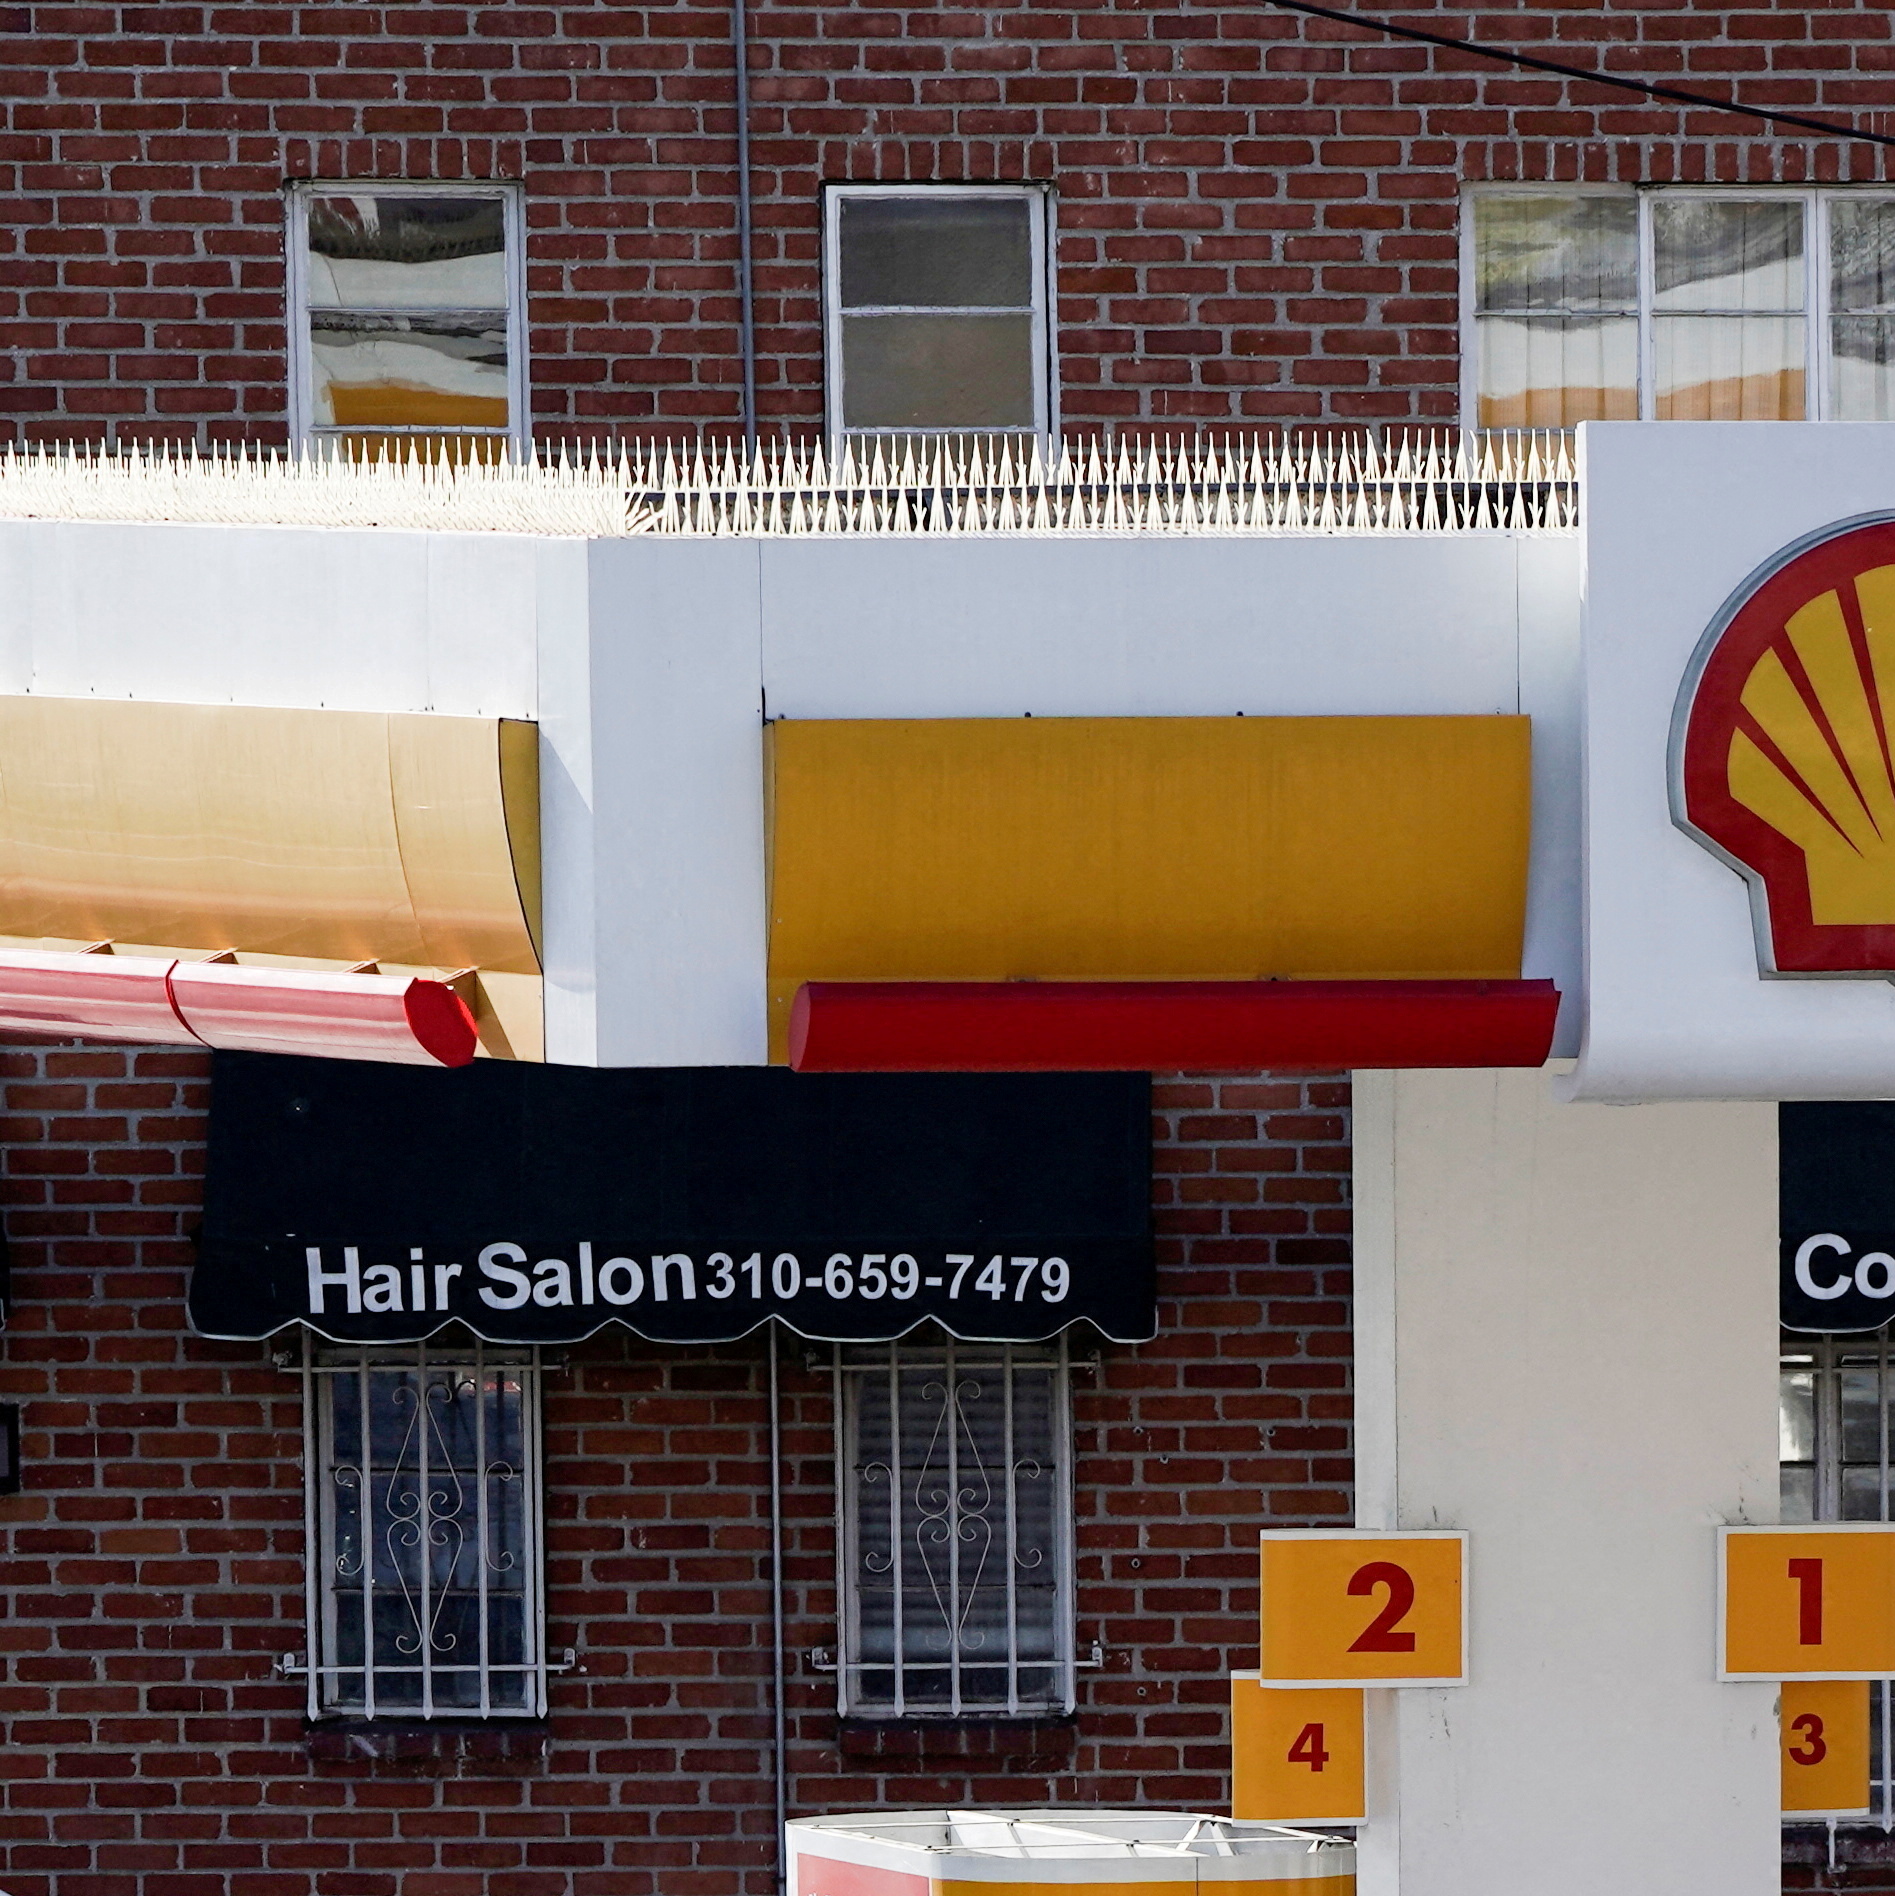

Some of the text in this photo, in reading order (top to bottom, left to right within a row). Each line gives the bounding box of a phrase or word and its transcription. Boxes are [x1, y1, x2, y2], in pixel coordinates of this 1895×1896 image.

[306, 1241, 1070, 1313] Hair Salon 310-659-7479
[1346, 1561, 1416, 1653] 2
[1787, 1558, 1823, 1646] 1
[1287, 1722, 1330, 1773] 4
[1788, 1713, 1827, 1767] 3
